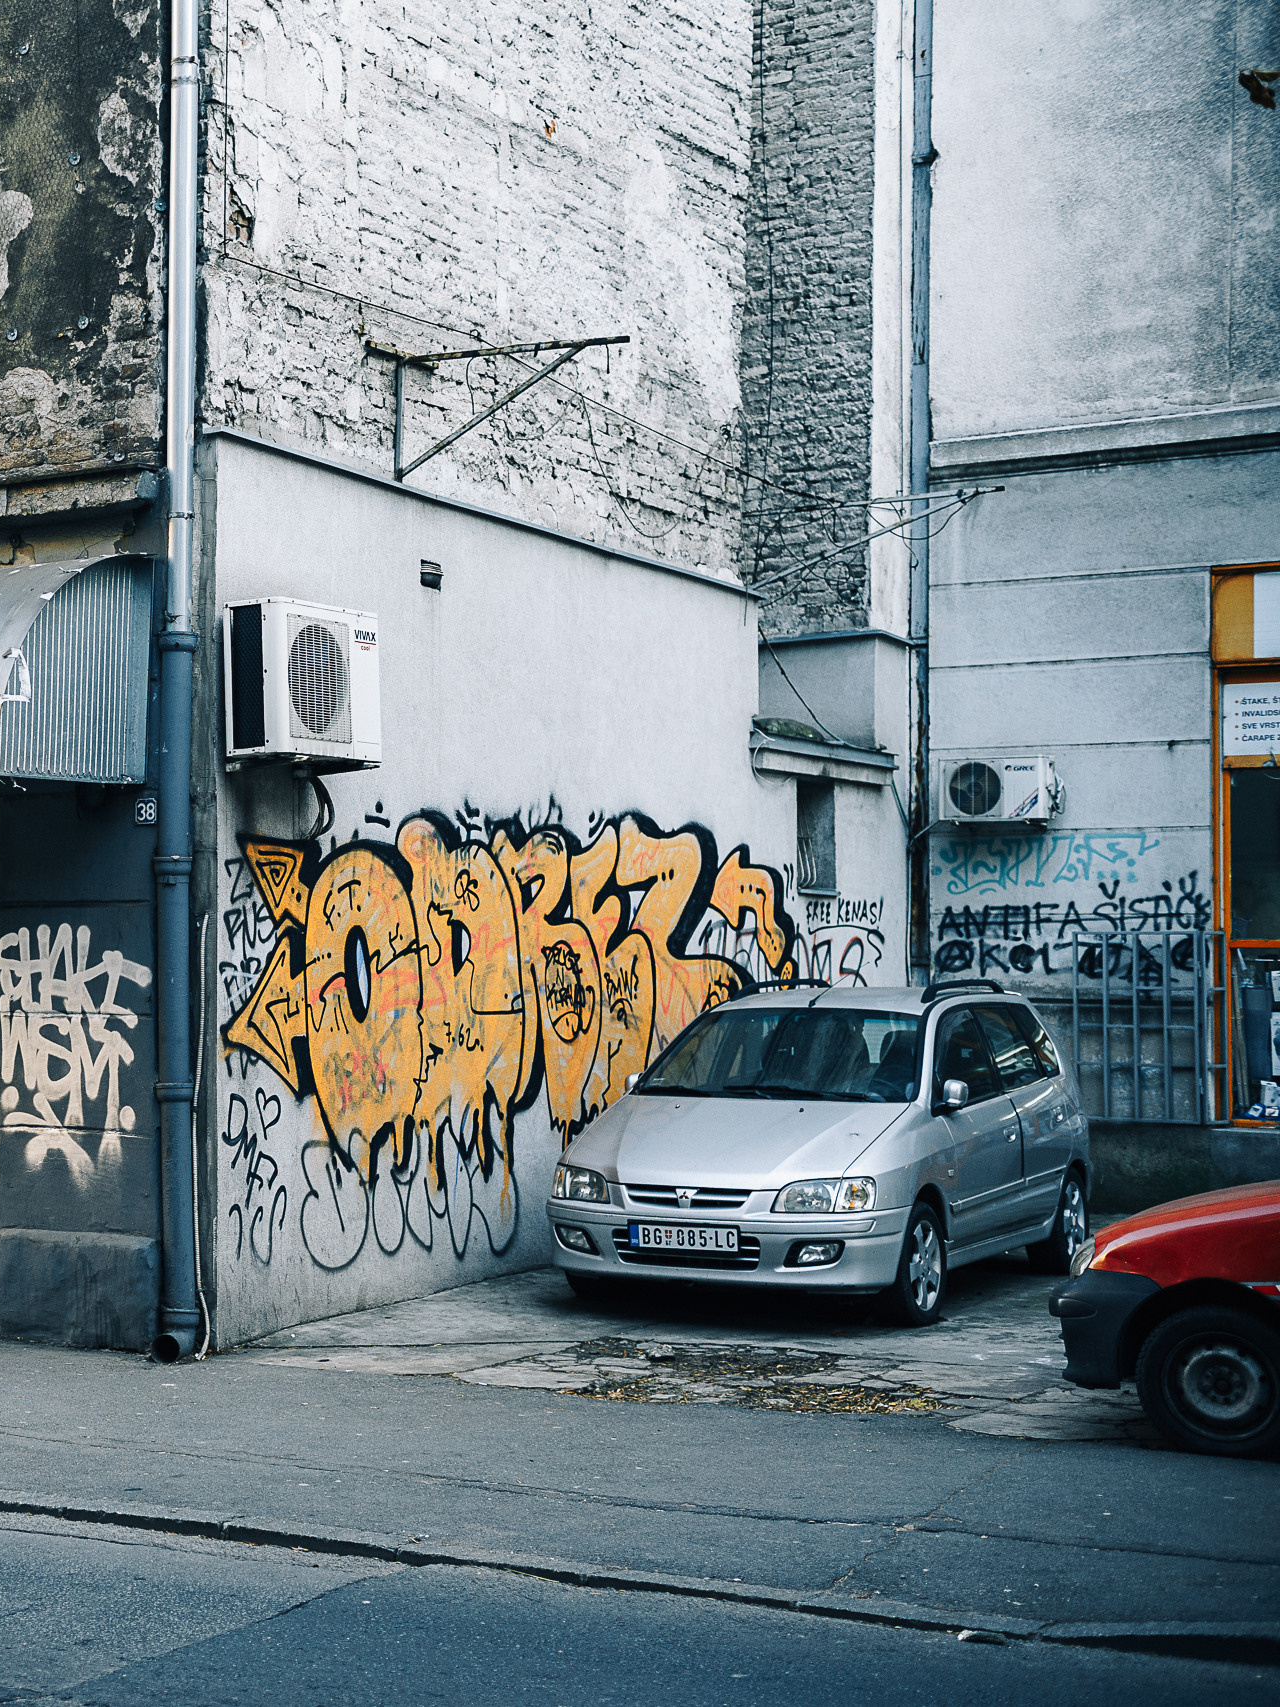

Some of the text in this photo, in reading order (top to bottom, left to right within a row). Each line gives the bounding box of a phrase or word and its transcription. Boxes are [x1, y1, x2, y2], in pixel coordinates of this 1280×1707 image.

[354, 629, 376, 643] VIVAX
[1241, 722, 1257, 730] SVE
[1241, 734, 1275, 742] ČARAPE
[137, 801, 155, 822] 38
[806, 896, 884, 926] FREE KENAS!
[641, 1226, 662, 1246] BG
